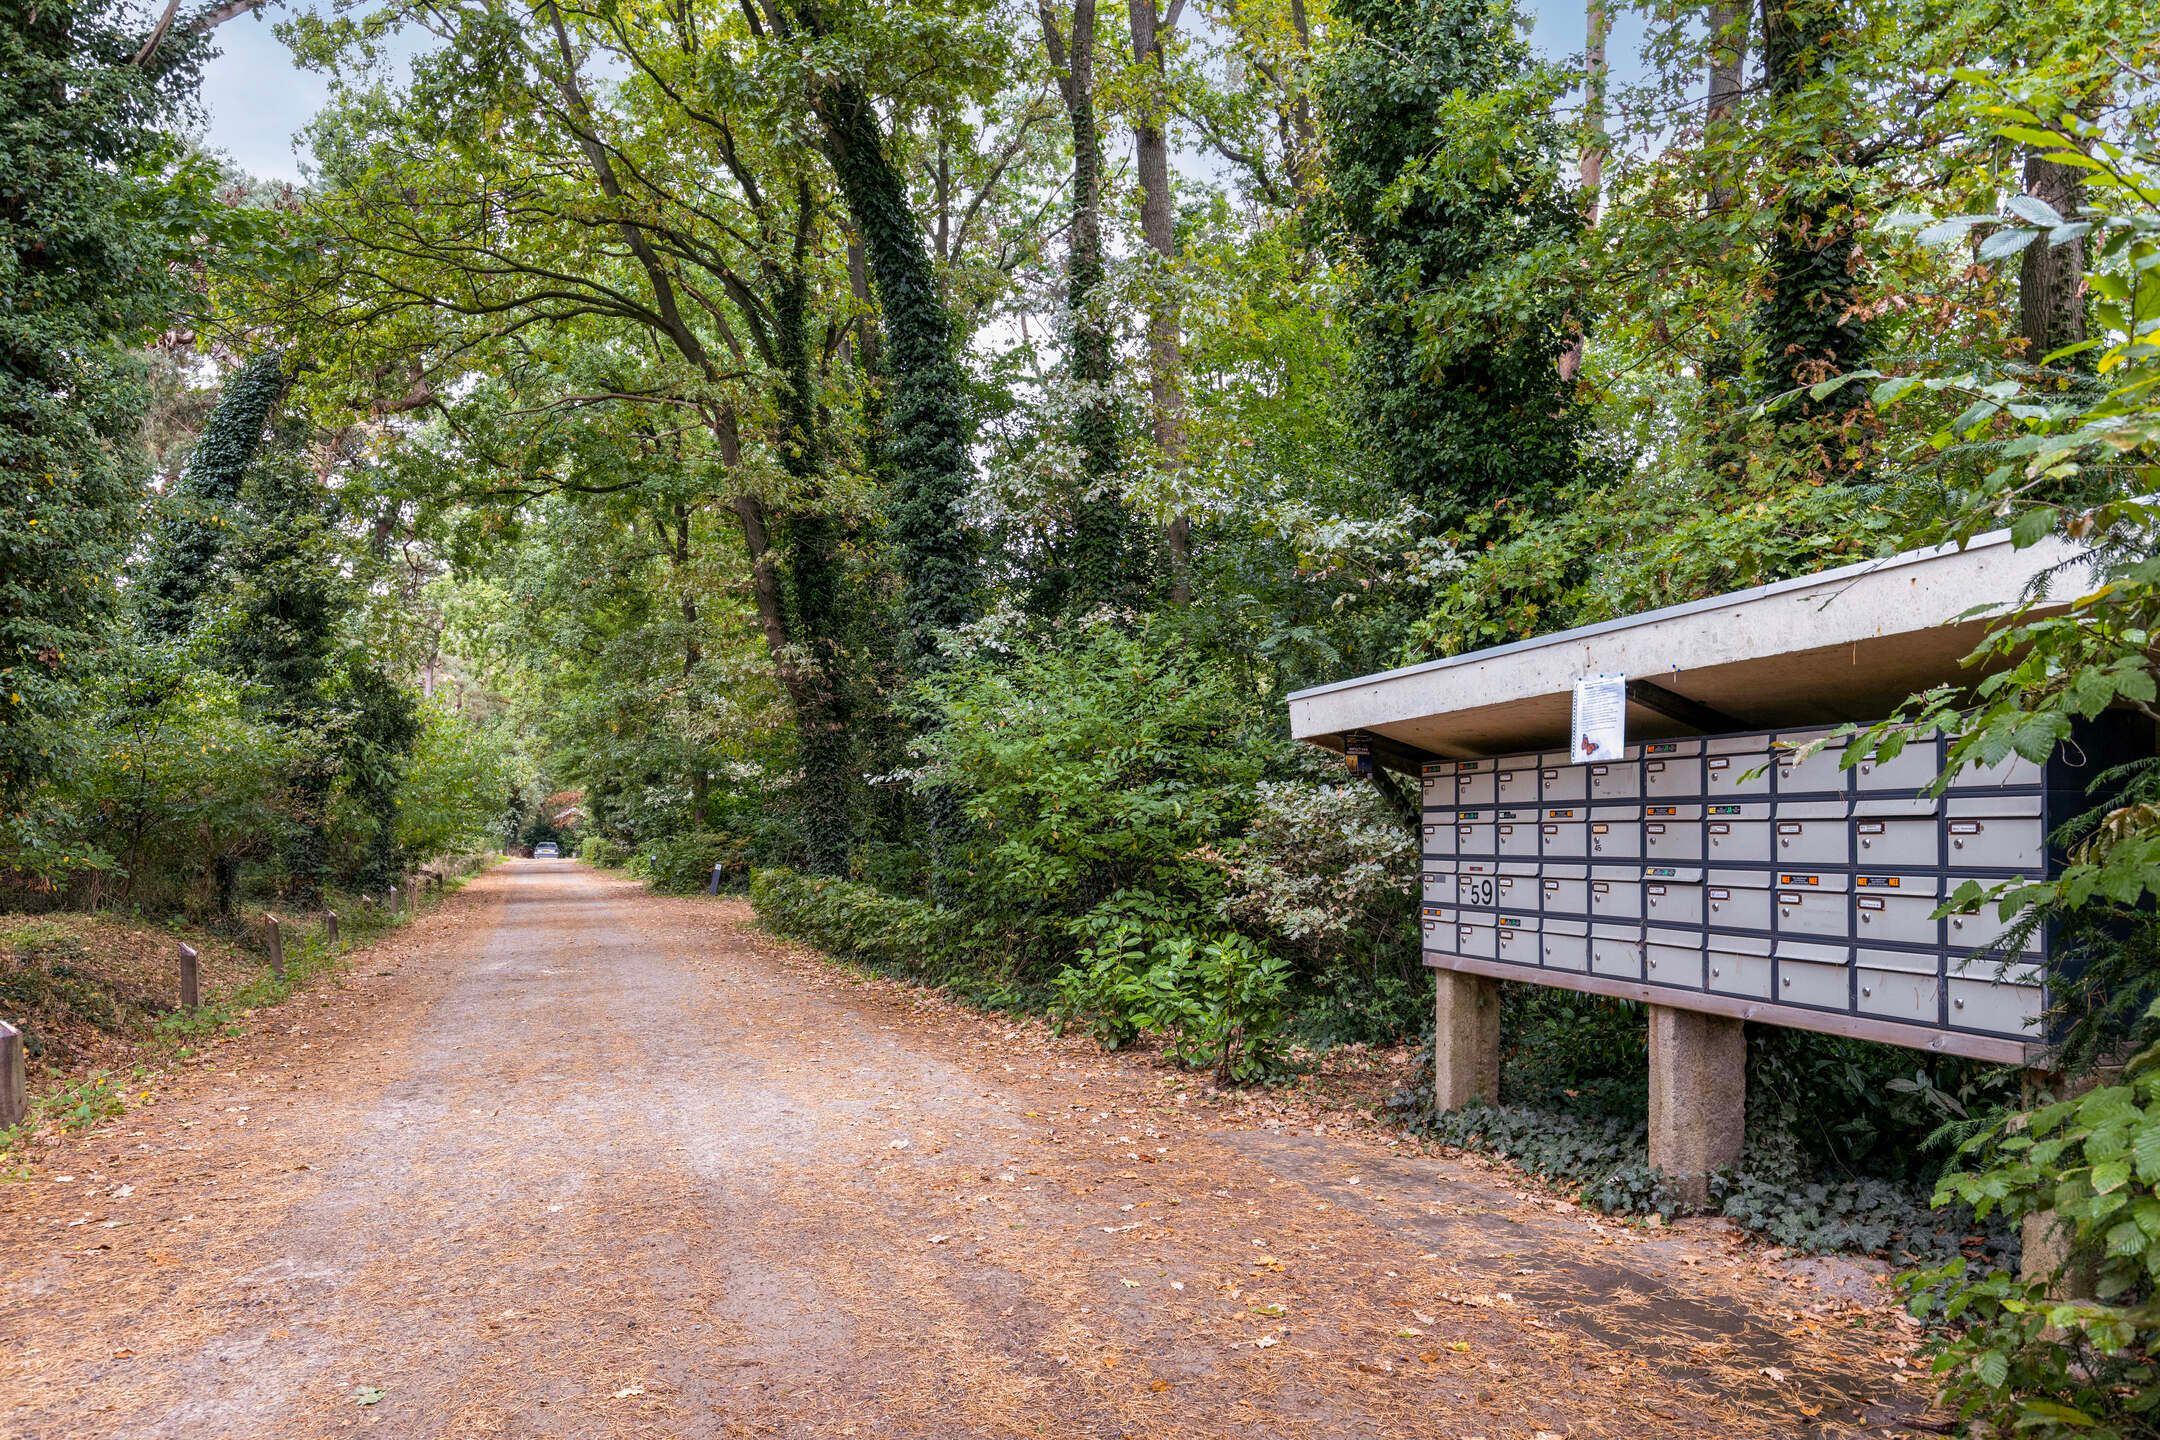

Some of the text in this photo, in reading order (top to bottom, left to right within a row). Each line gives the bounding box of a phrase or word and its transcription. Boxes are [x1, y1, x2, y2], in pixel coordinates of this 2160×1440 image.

[1809, 877, 1818, 885] NEE
[1858, 877, 1868, 886] NEE
[1889, 878, 1900, 887] NEE
[1471, 879, 1493, 905] 59
